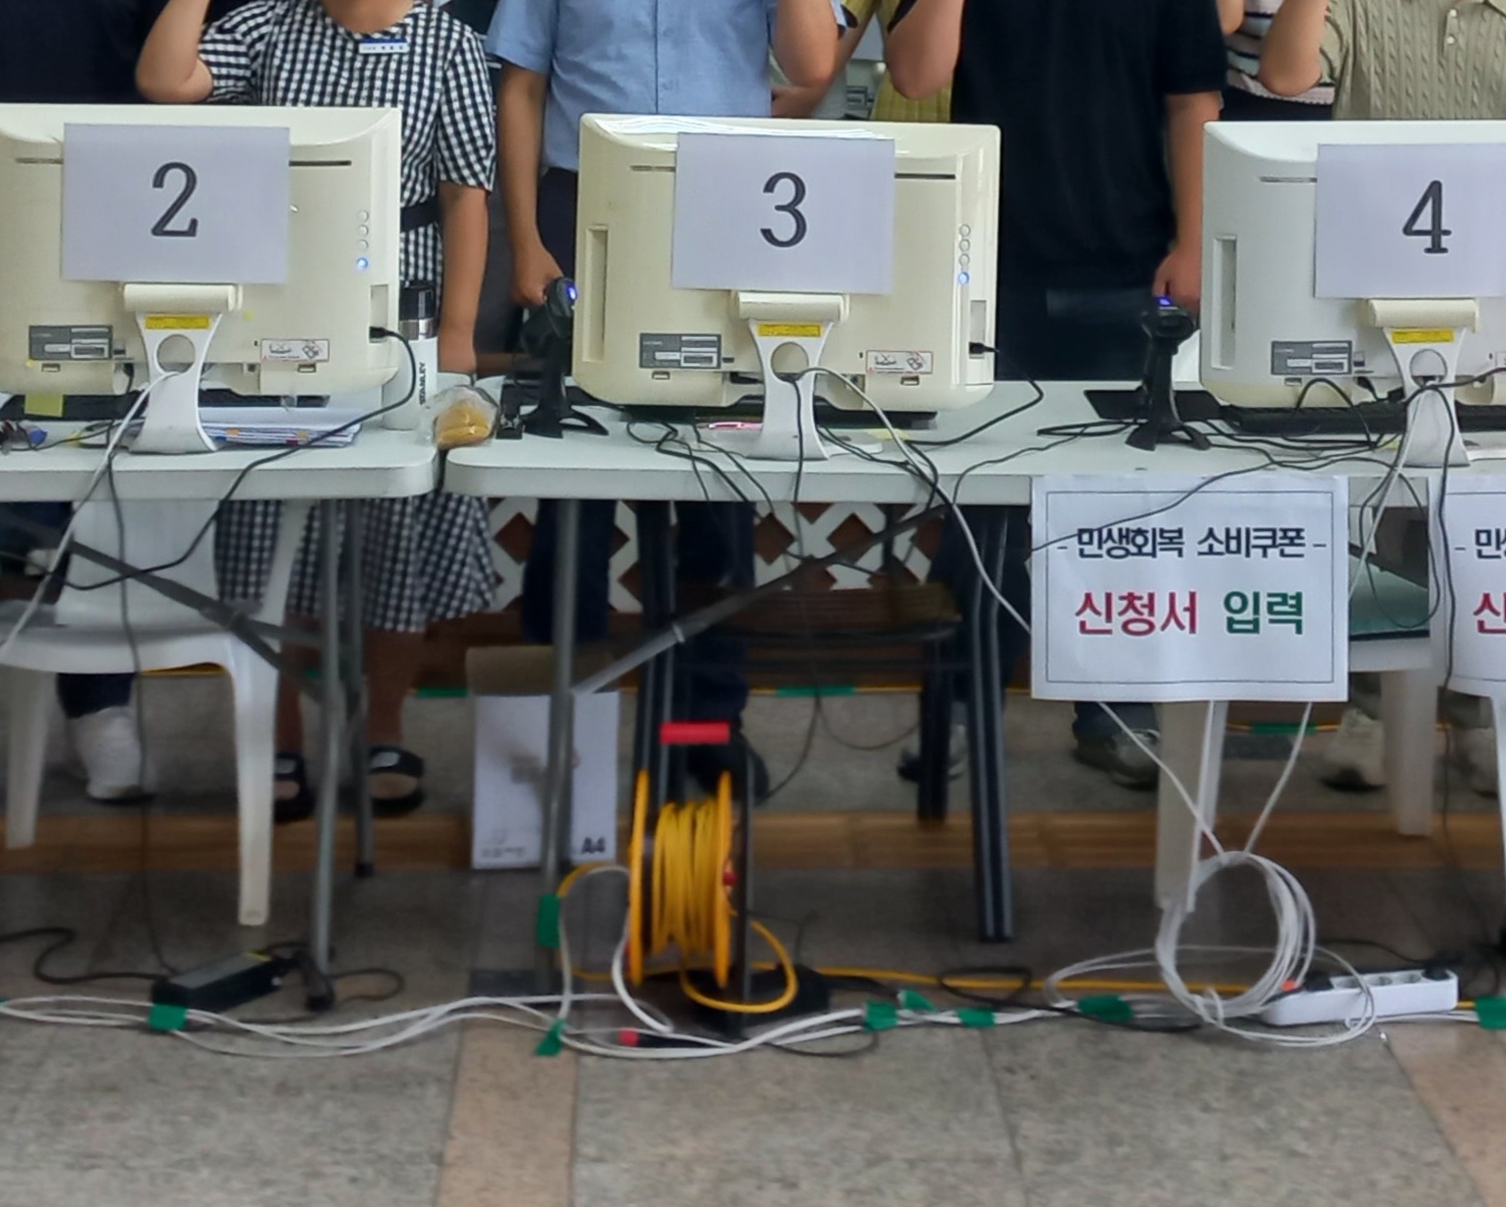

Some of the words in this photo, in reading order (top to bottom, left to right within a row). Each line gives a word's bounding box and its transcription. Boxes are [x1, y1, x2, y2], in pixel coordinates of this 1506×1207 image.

[151, 161, 198, 238] 2
[759, 171, 808, 248] 3
[1402, 180, 1452, 254] 4
[1076, 527, 1184, 559] 민생회복
[1197, 527, 1306, 558] 소비쿠폰
[1074, 590, 1198, 636] 신청서
[1223, 591, 1303, 635] 입력
[581, 836, 606, 854] A4
